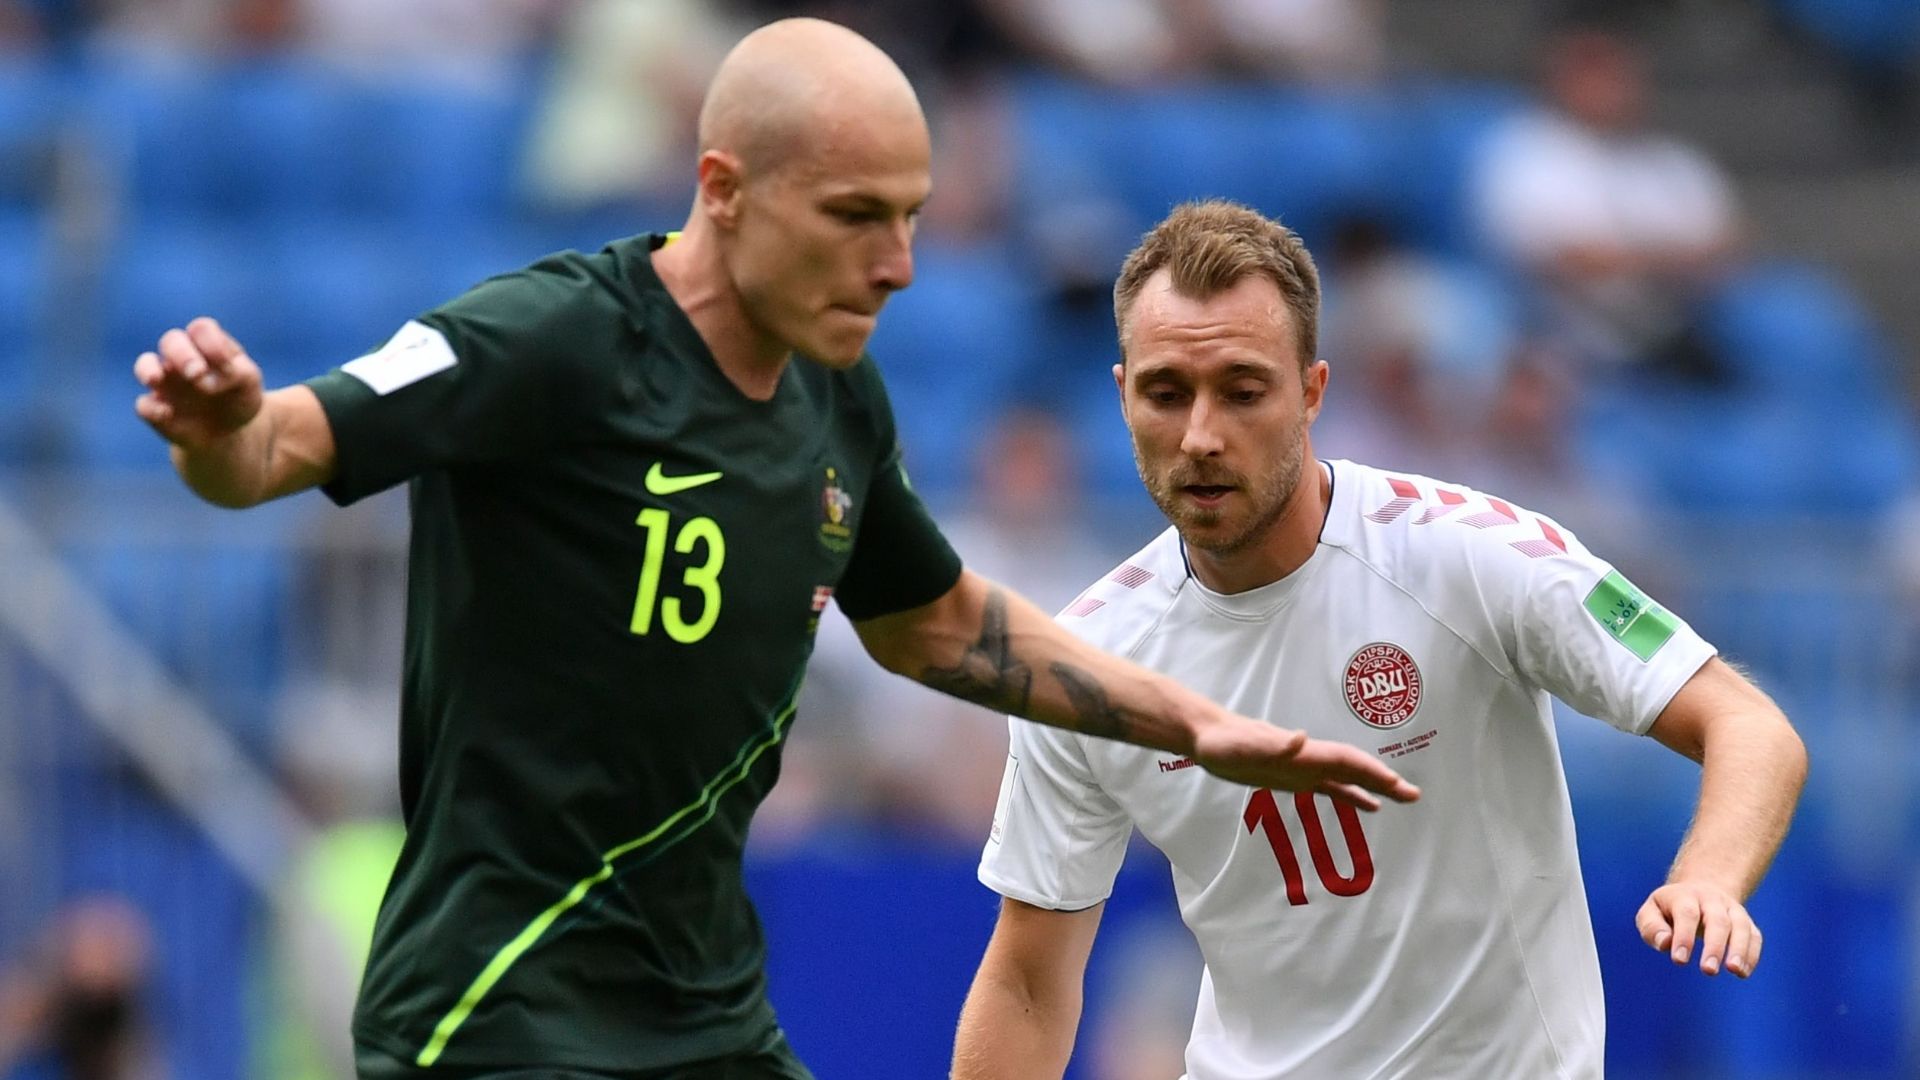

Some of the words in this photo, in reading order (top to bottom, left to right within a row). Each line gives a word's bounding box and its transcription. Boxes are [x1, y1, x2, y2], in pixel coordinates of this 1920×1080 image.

[629, 508, 726, 644] 13
[1346, 675, 1373, 719] DANSK
[1405, 662, 1419, 707] UNION
[1359, 669, 1407, 700] DBU
[1377, 709, 1407, 725] 1889
[1158, 758, 1195, 772] humm
[1244, 786, 1374, 906] 10
